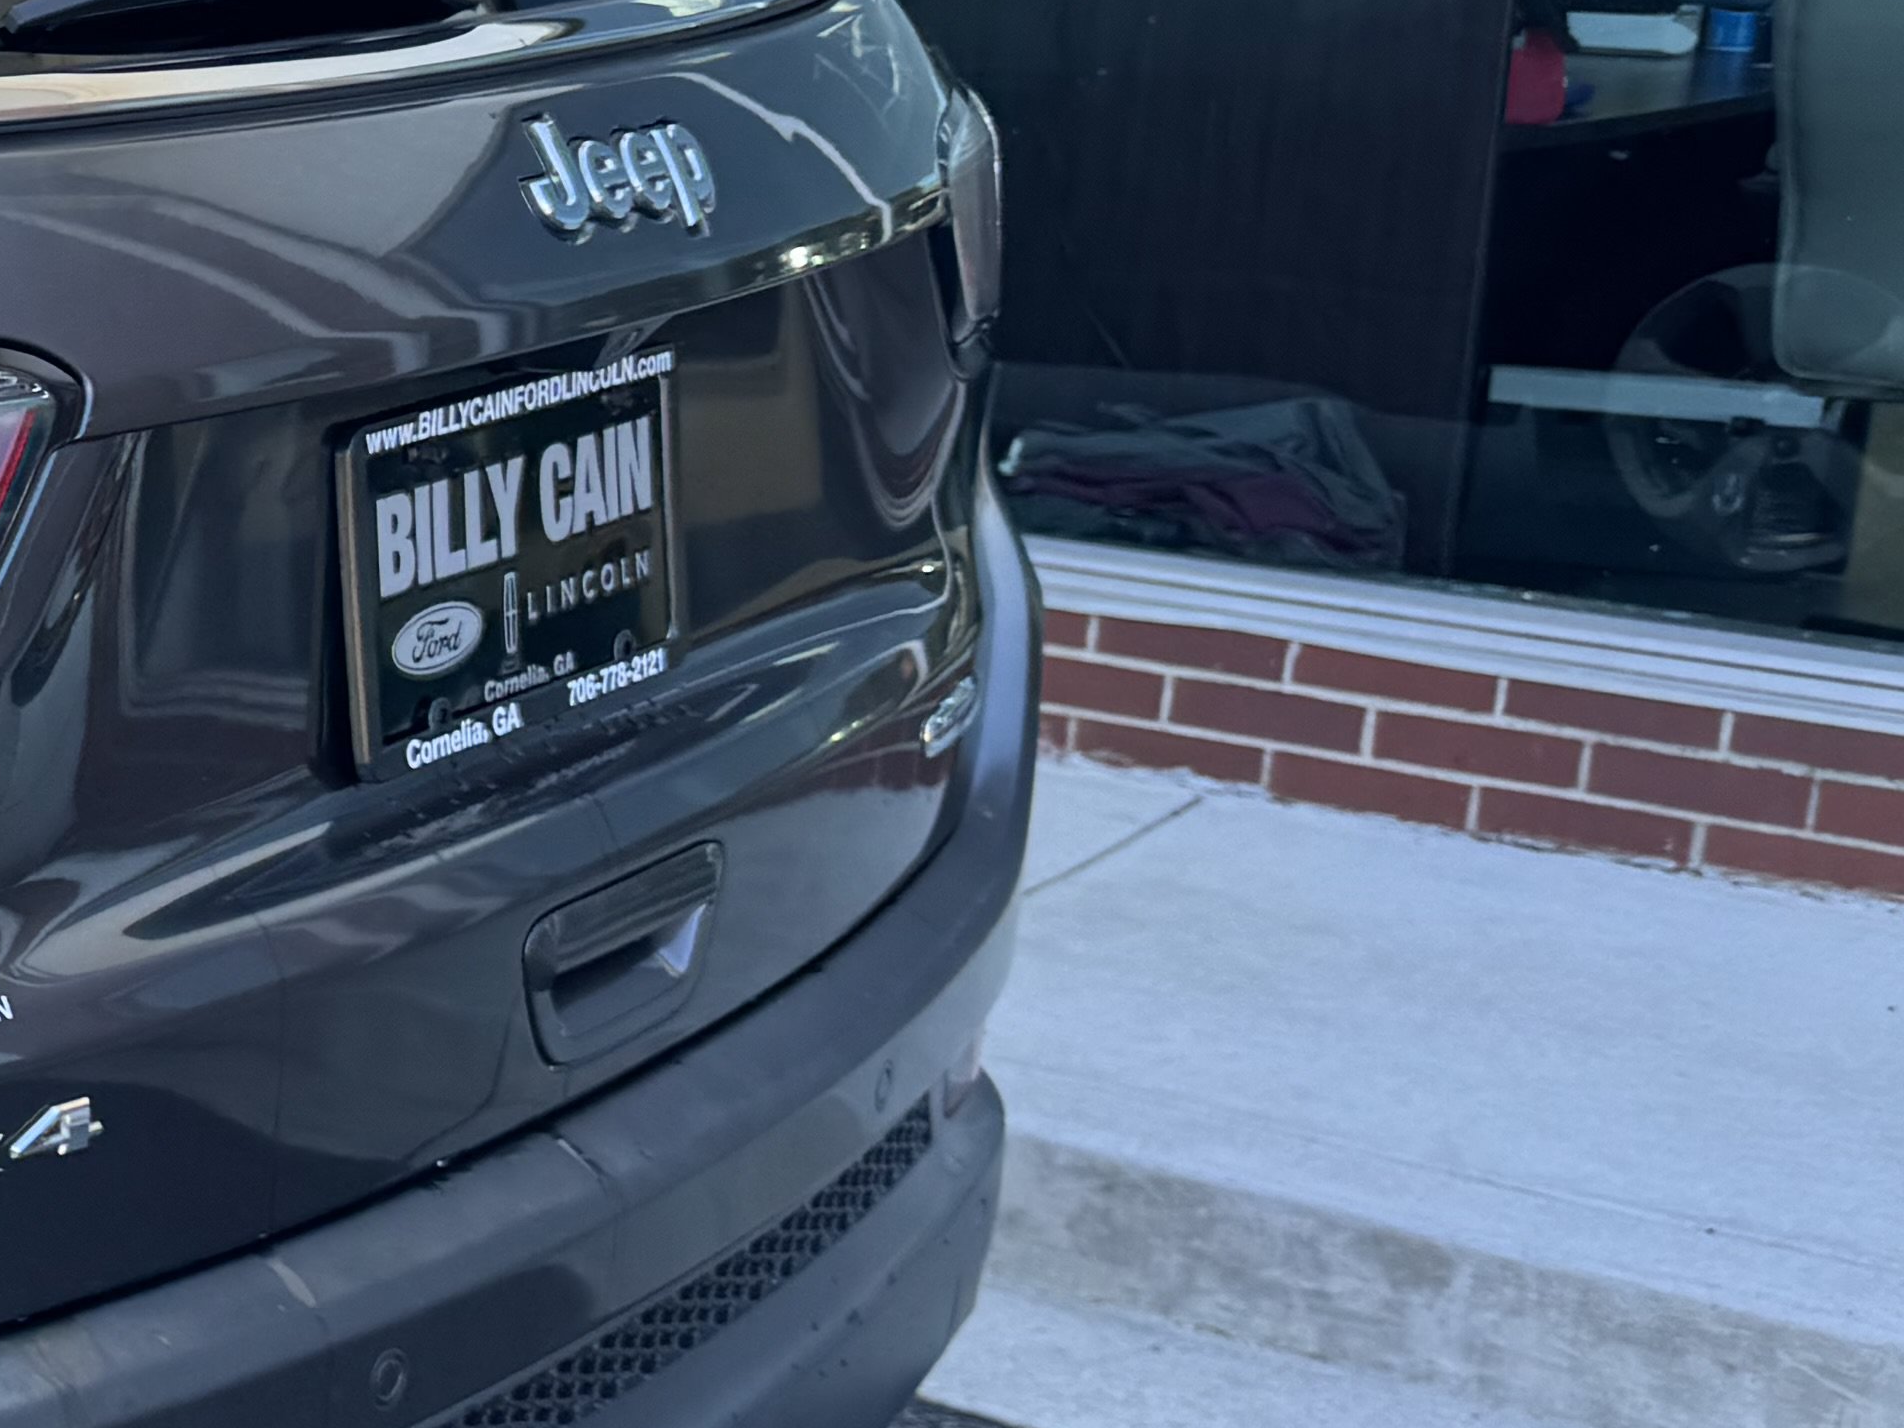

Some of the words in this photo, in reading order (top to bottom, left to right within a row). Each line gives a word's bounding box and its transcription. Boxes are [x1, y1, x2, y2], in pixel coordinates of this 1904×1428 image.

[518, 113, 716, 243] Jeep
[376, 455, 526, 598] BILLY
[539, 417, 653, 543] CAIN
[526, 549, 652, 621] LINCOLN
[412, 618, 462, 663] Ford
[553, 651, 576, 674] GA
[566, 647, 667, 706] 706-778-2121
[492, 702, 523, 737] GA
